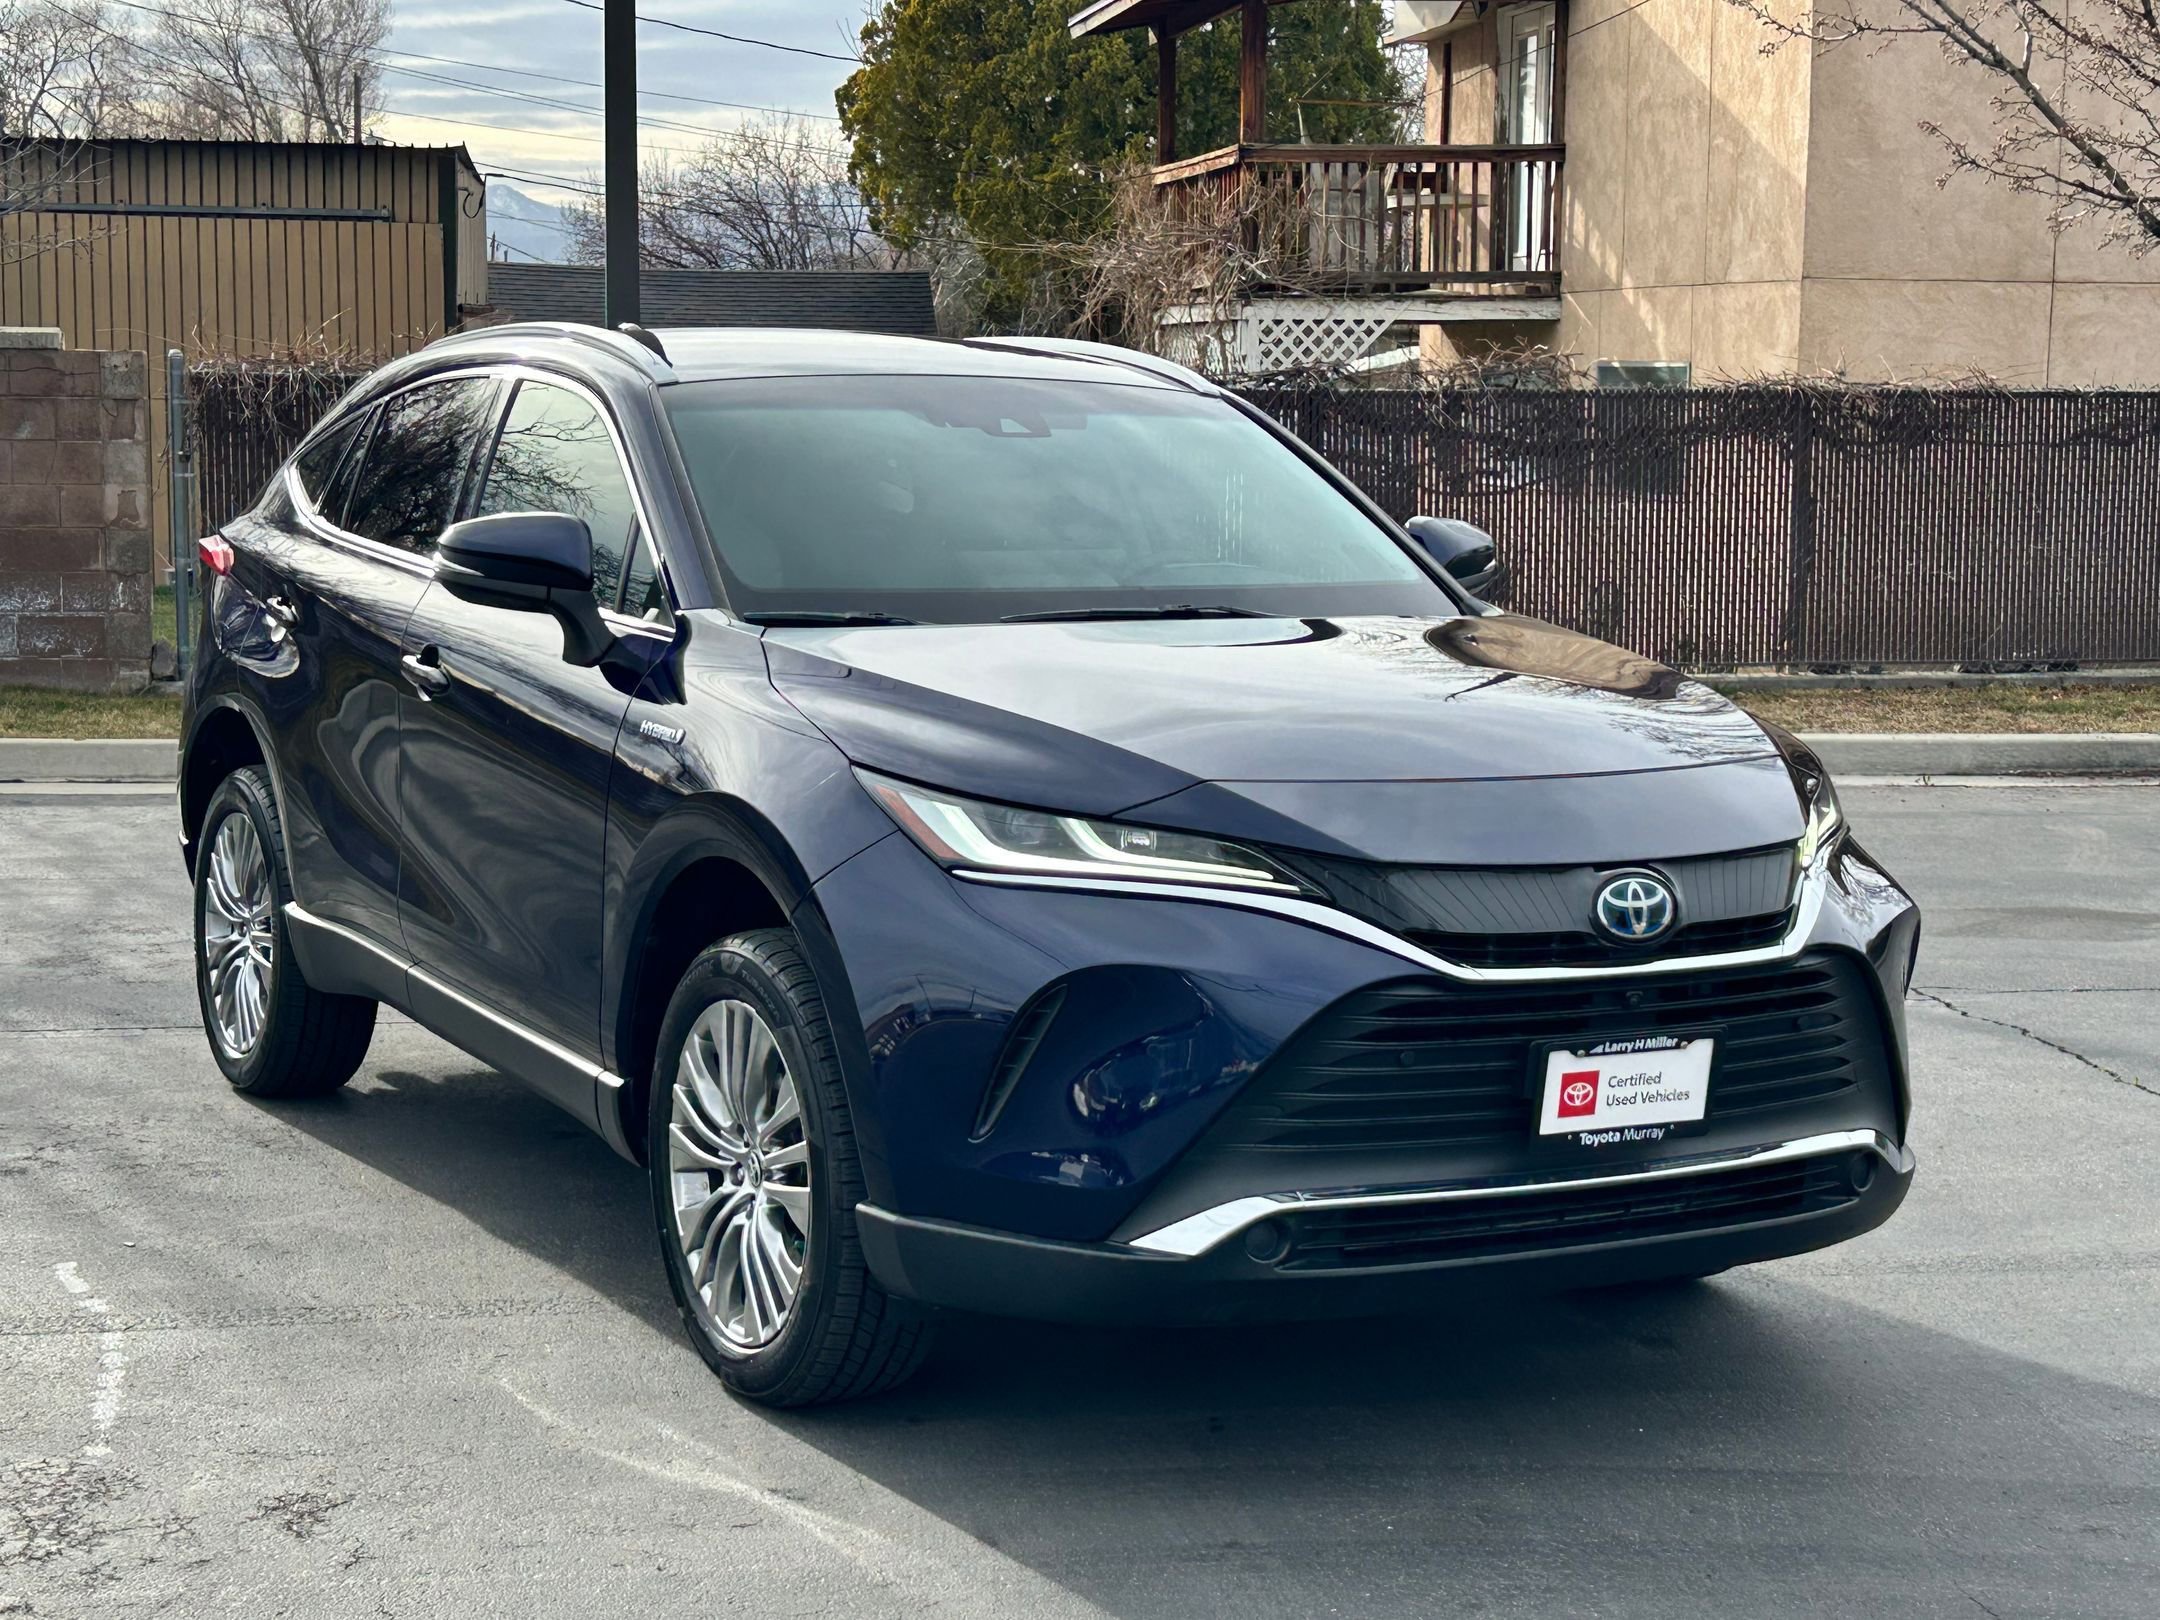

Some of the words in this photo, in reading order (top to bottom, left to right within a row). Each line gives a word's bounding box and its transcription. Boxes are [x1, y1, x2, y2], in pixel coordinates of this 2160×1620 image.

[1604, 1041, 1634, 1053] Larry
[1635, 1039, 1645, 1050] H
[1645, 1036, 1679, 1049] Miller
[1608, 1072, 1662, 1088] Certified
[1606, 1093, 1637, 1107] Used
[1640, 1088, 1690, 1104] Vehicles
[1579, 1130, 1621, 1147] Toyota
[1622, 1126, 1665, 1142] Murray
